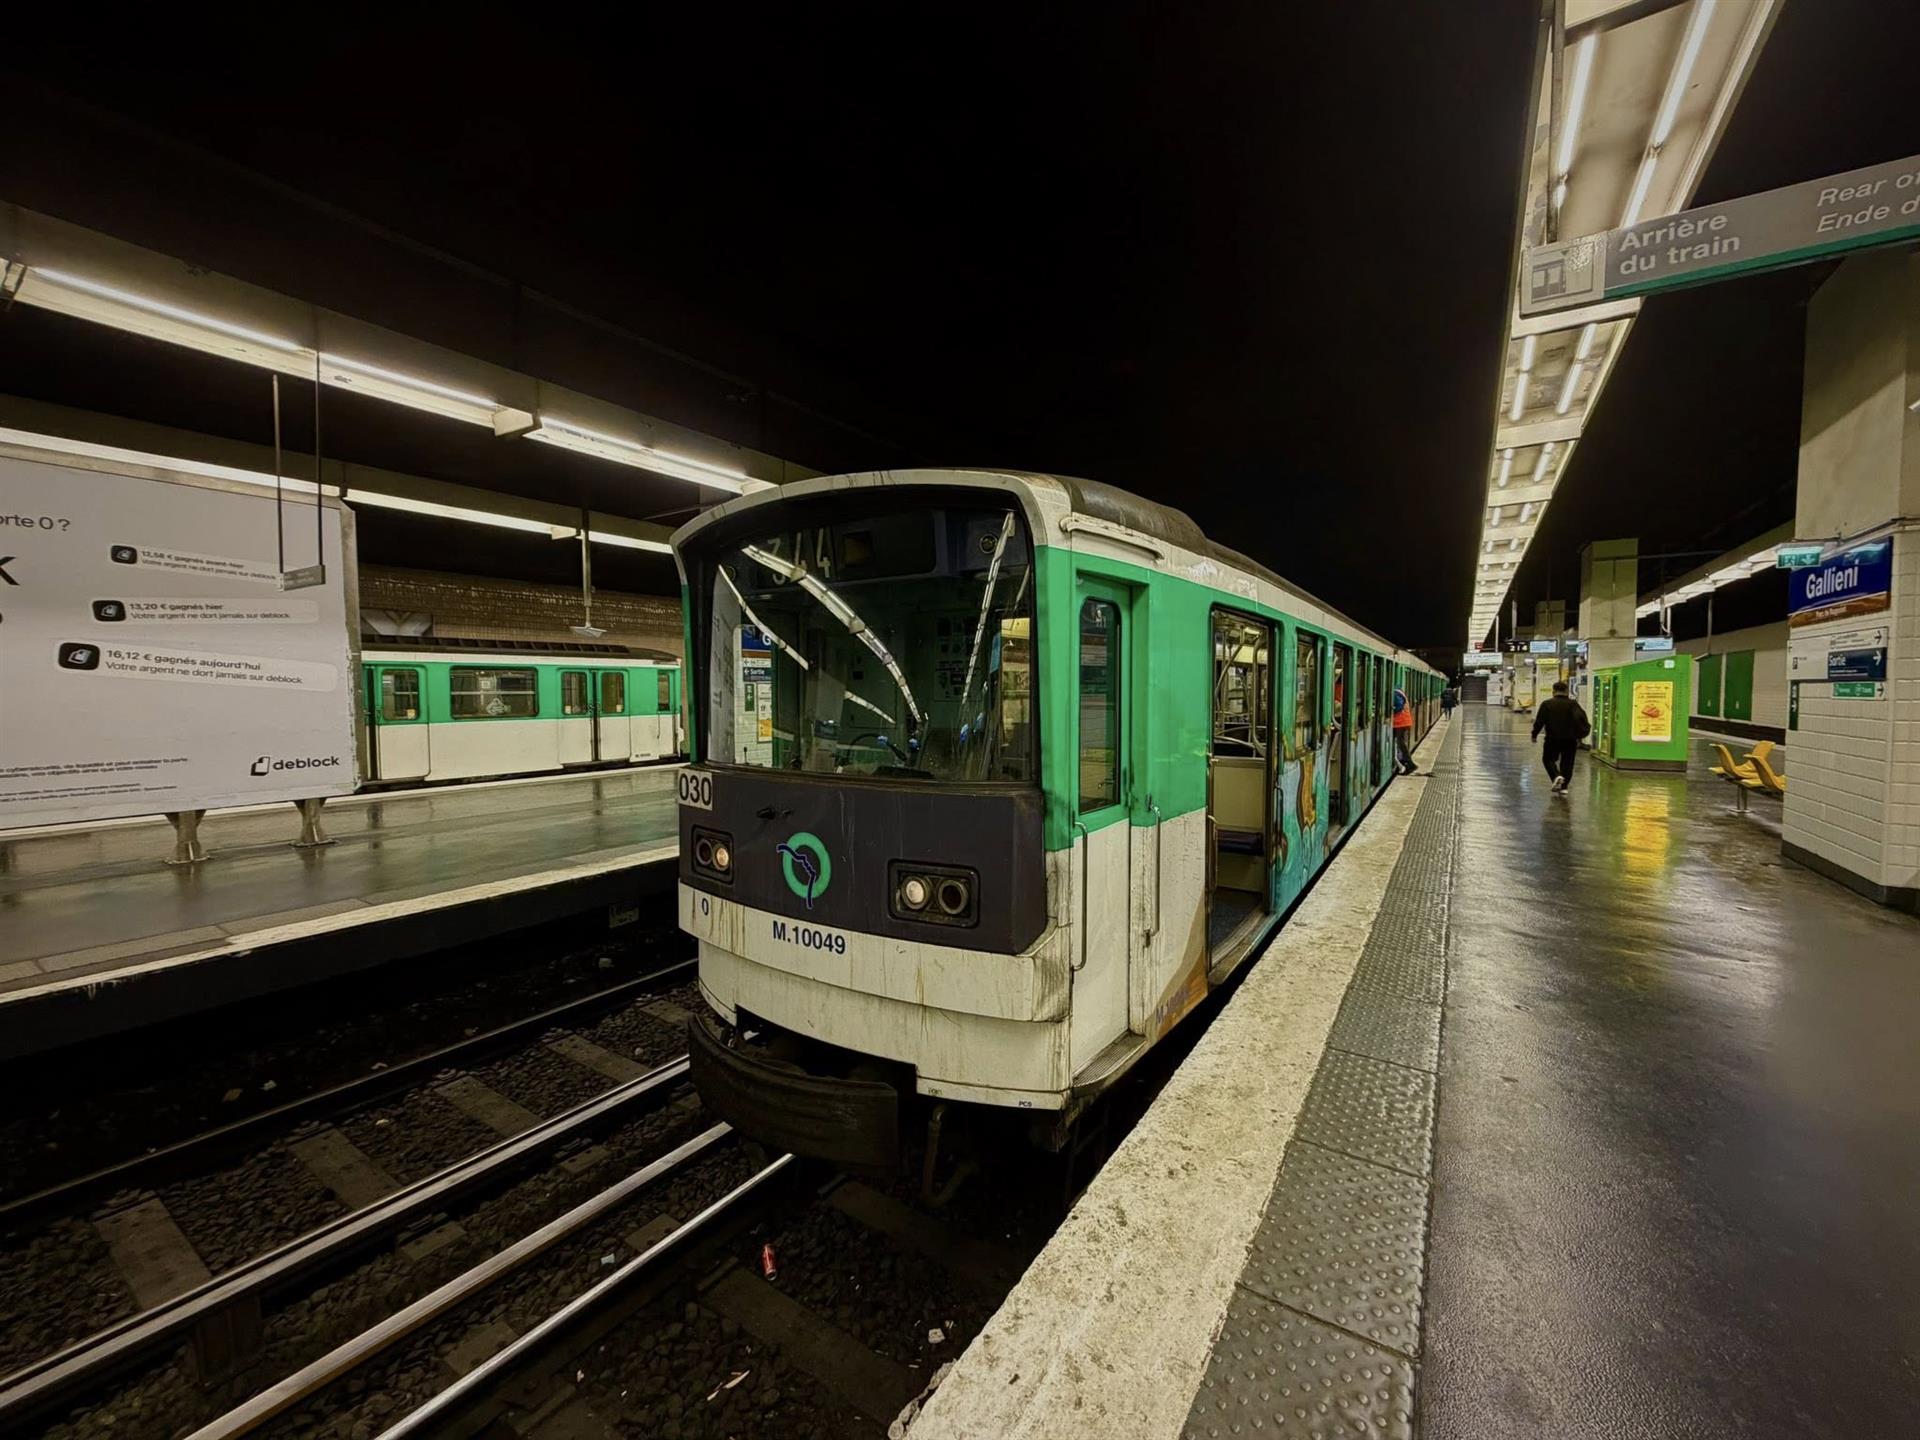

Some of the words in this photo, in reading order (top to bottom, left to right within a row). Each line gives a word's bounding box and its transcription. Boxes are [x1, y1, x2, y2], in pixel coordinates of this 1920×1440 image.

[1817, 180, 1887, 207] Rear
[1816, 205, 1890, 233] Ende
[1619, 215, 1728, 252] Arrière
[1620, 254, 1656, 275] du
[1667, 236, 1740, 265] train
[1805, 559, 1859, 599] Gallieni
[129, 603, 158, 611] 13,20
[169, 603, 203, 611] gagnés
[158, 612, 186, 620] argent
[218, 612, 245, 620] jamais
[105, 661, 137, 672] Votre
[139, 665, 175, 675] argent
[192, 669, 214, 677] dort
[215, 671, 247, 680] jamais
[249, 674, 264, 682] sur
[266, 675, 304, 684] deblock
[106, 650, 141, 661] 16,12
[143, 653, 152, 661] €
[154, 654, 197, 666] gagnés
[199, 659, 261, 670] aujourd'hui
[272, 755, 340, 770] deblock
[679, 773, 712, 806] 030
[702, 898, 709, 916] 0
[773, 920, 846, 955] M.10049
